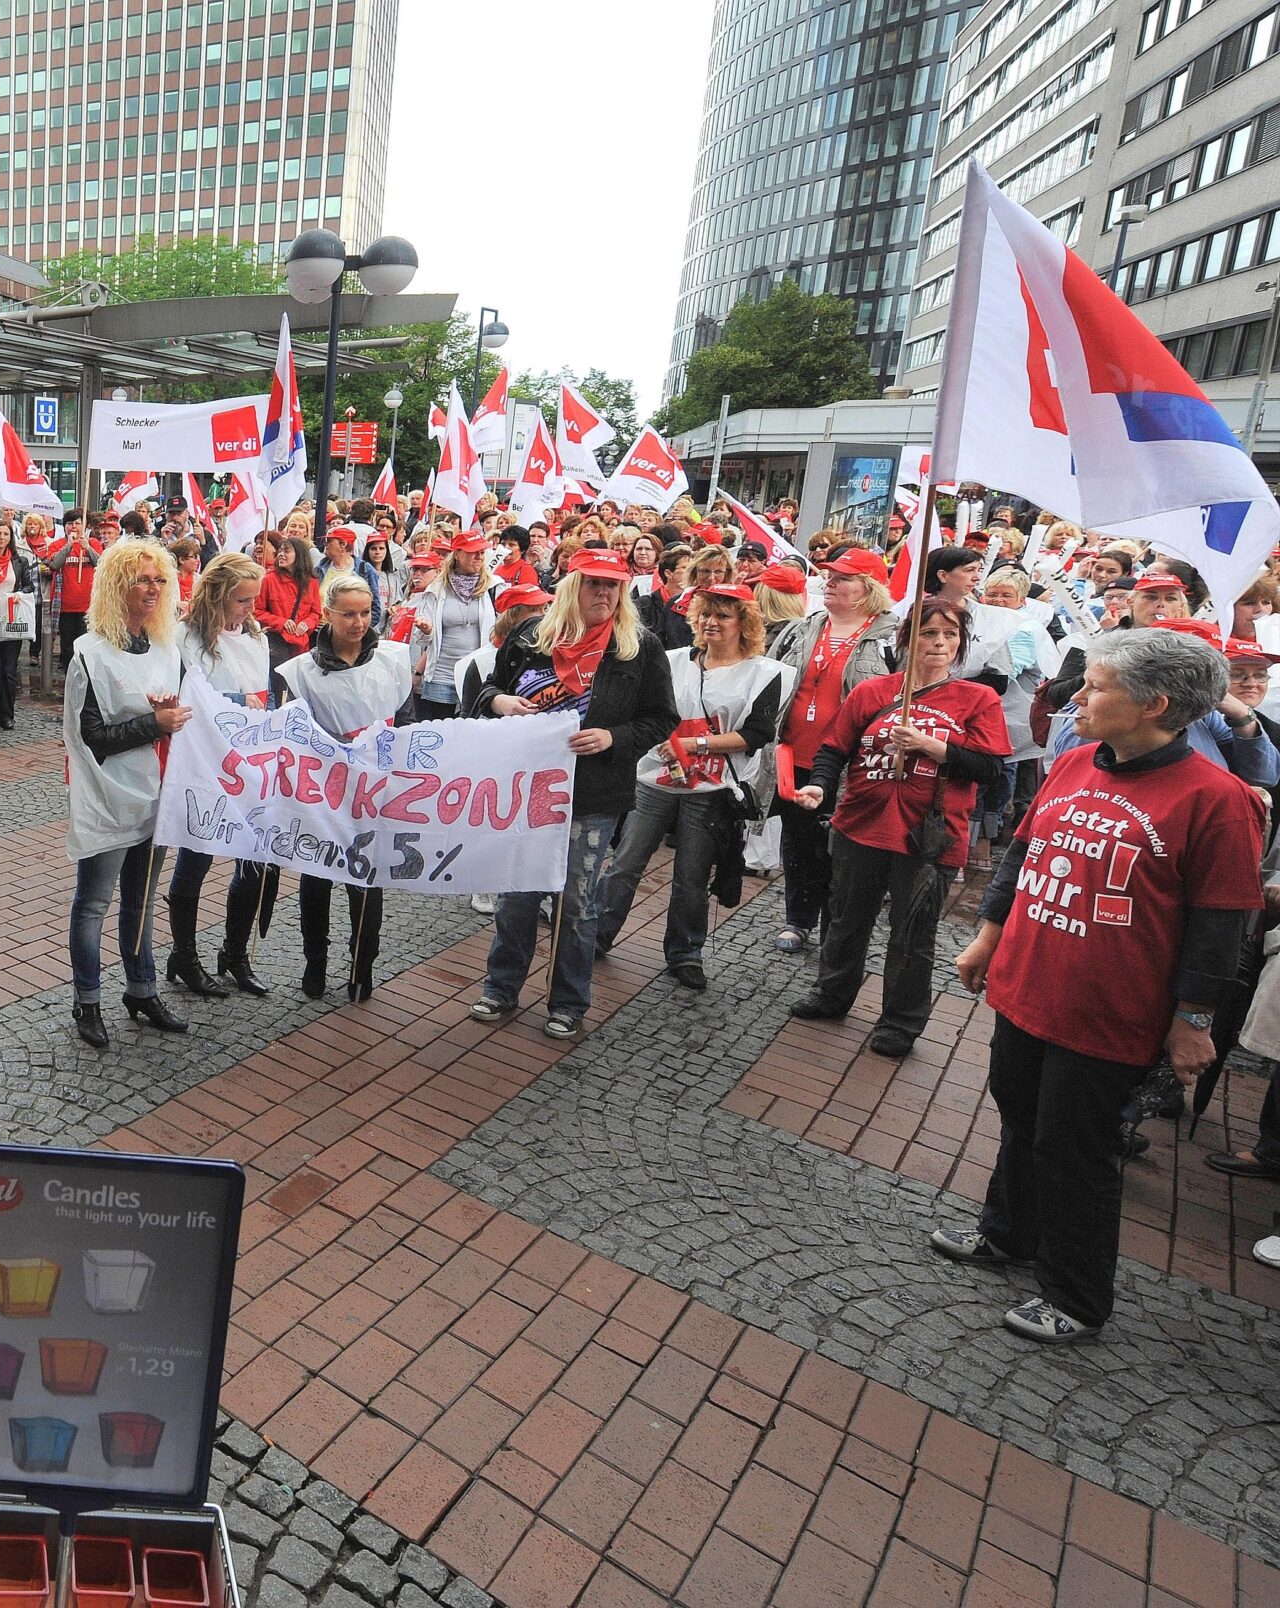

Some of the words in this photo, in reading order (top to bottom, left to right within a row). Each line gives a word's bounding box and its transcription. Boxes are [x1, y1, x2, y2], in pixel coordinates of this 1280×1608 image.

[115, 416, 160, 428] Schlecker
[122, 439, 142, 450] Marl
[184, 788, 243, 844] Wir
[428, 843, 463, 882] %
[1058, 803, 1130, 839] Jetzt
[1093, 789, 1110, 801] im
[1110, 794, 1169, 858] Einzelhandel
[1050, 829, 1108, 860] sind
[1017, 864, 1083, 908] wir
[1027, 900, 1087, 938] dran
[43, 1178, 141, 1209] Candles
[55, 1204, 81, 1219] that
[85, 1208, 116, 1224] light
[118, 1211, 134, 1226] up
[138, 1209, 181, 1230] your
[186, 1210, 217, 1230] life
[128, 1356, 175, 1378] 1,29
